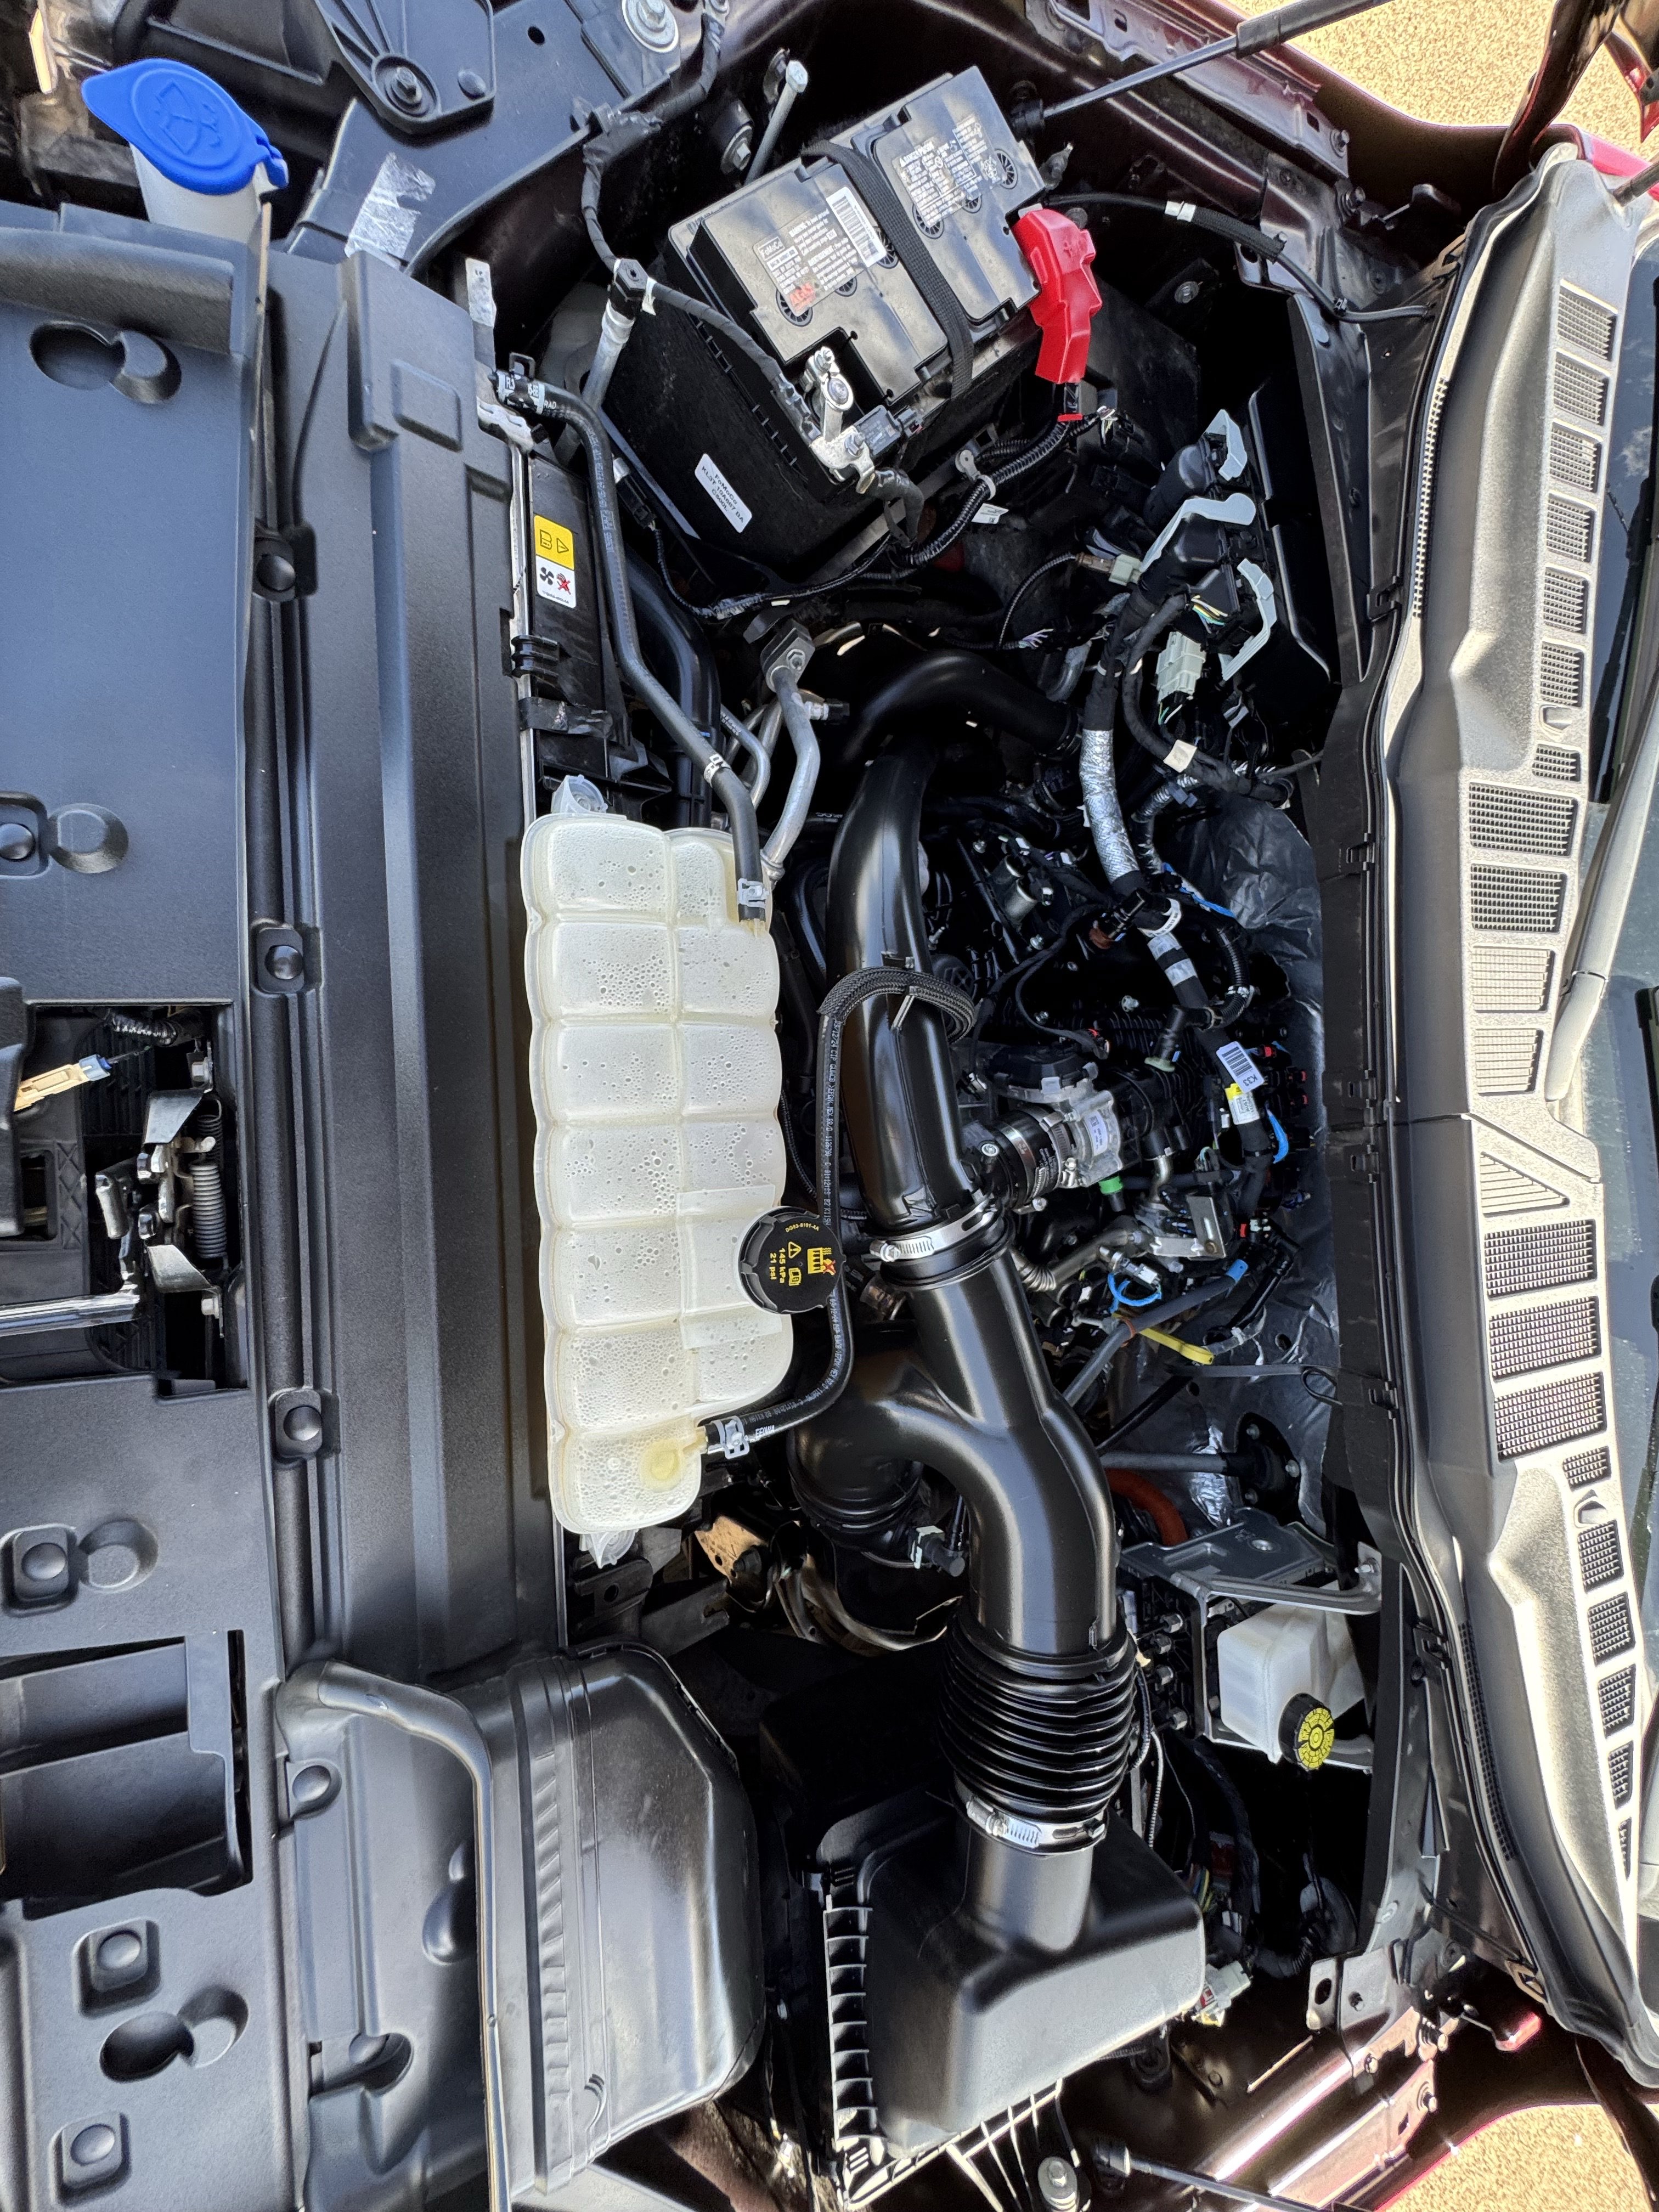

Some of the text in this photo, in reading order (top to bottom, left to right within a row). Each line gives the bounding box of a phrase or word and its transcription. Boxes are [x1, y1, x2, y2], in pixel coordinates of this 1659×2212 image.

[544, 400, 556, 410] RAD
[714, 474, 737, 505] FoMoCo
[1243, 1074, 1258, 1086] K33
[769, 1252, 777, 1280] 21 psi
